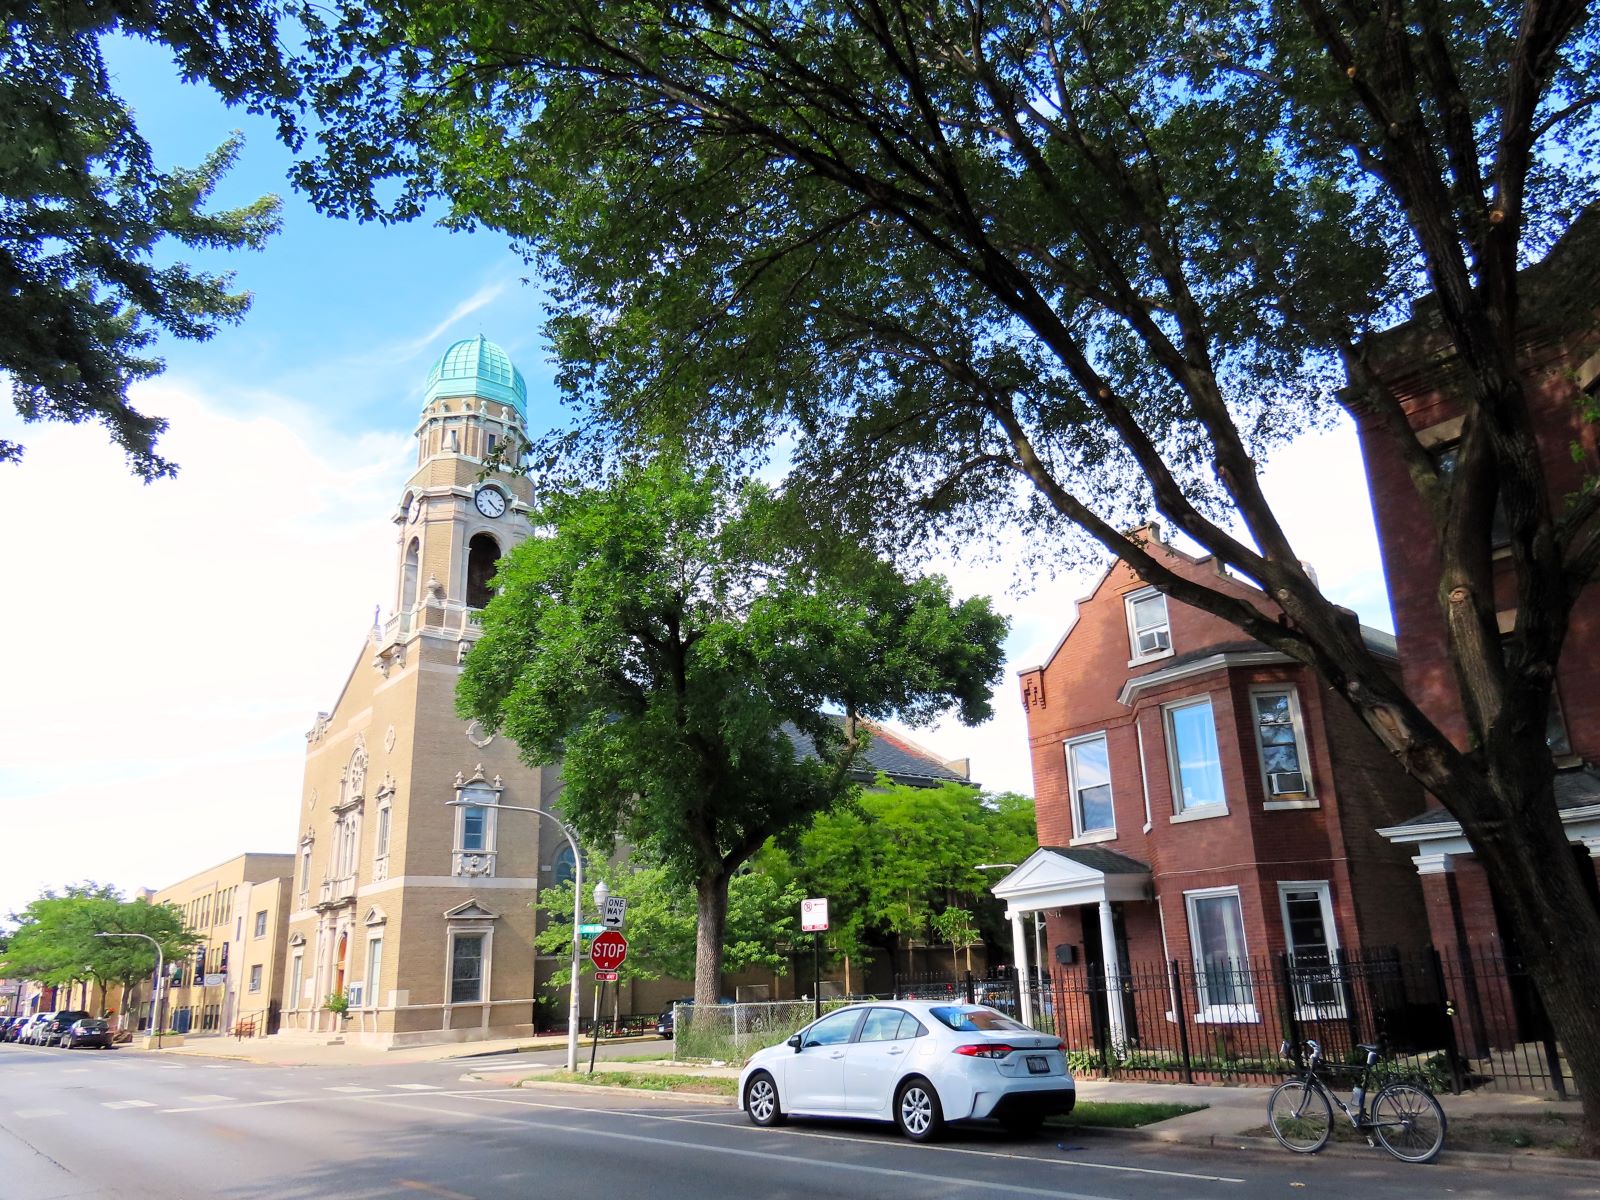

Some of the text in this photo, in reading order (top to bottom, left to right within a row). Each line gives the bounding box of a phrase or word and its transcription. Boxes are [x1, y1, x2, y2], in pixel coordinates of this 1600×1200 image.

[608, 899, 624, 907] ONE
[607, 908, 623, 916] WAY
[594, 943, 625, 958] STOP
